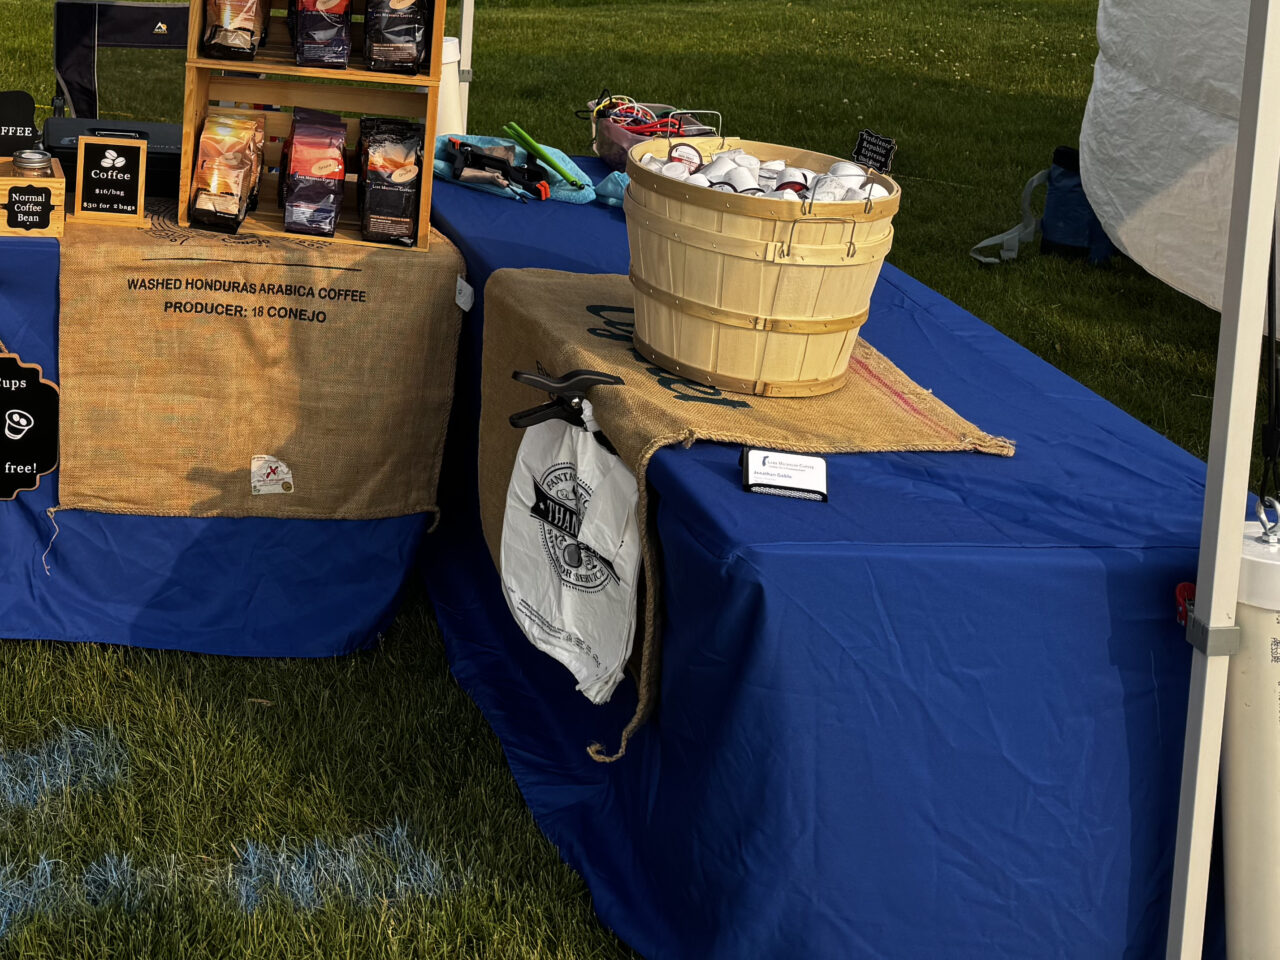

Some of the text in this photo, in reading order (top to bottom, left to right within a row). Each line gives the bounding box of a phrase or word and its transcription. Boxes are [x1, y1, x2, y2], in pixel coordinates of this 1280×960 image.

[91, 169, 131, 180] Coffee
[11, 192, 46, 203] Normal
[95, 188, 125, 197] $16/bag
[14, 203, 42, 213] Coffee
[118, 203, 136, 211] bags
[17, 213, 39, 222] Bean
[127, 277, 367, 303] WASHED HONDURAS ARABICA COFFEE
[164, 301, 327, 324] PRODUCER: 18 CONEJO
[5, 461, 38, 474] free!
[546, 500, 579, 539] THAN
